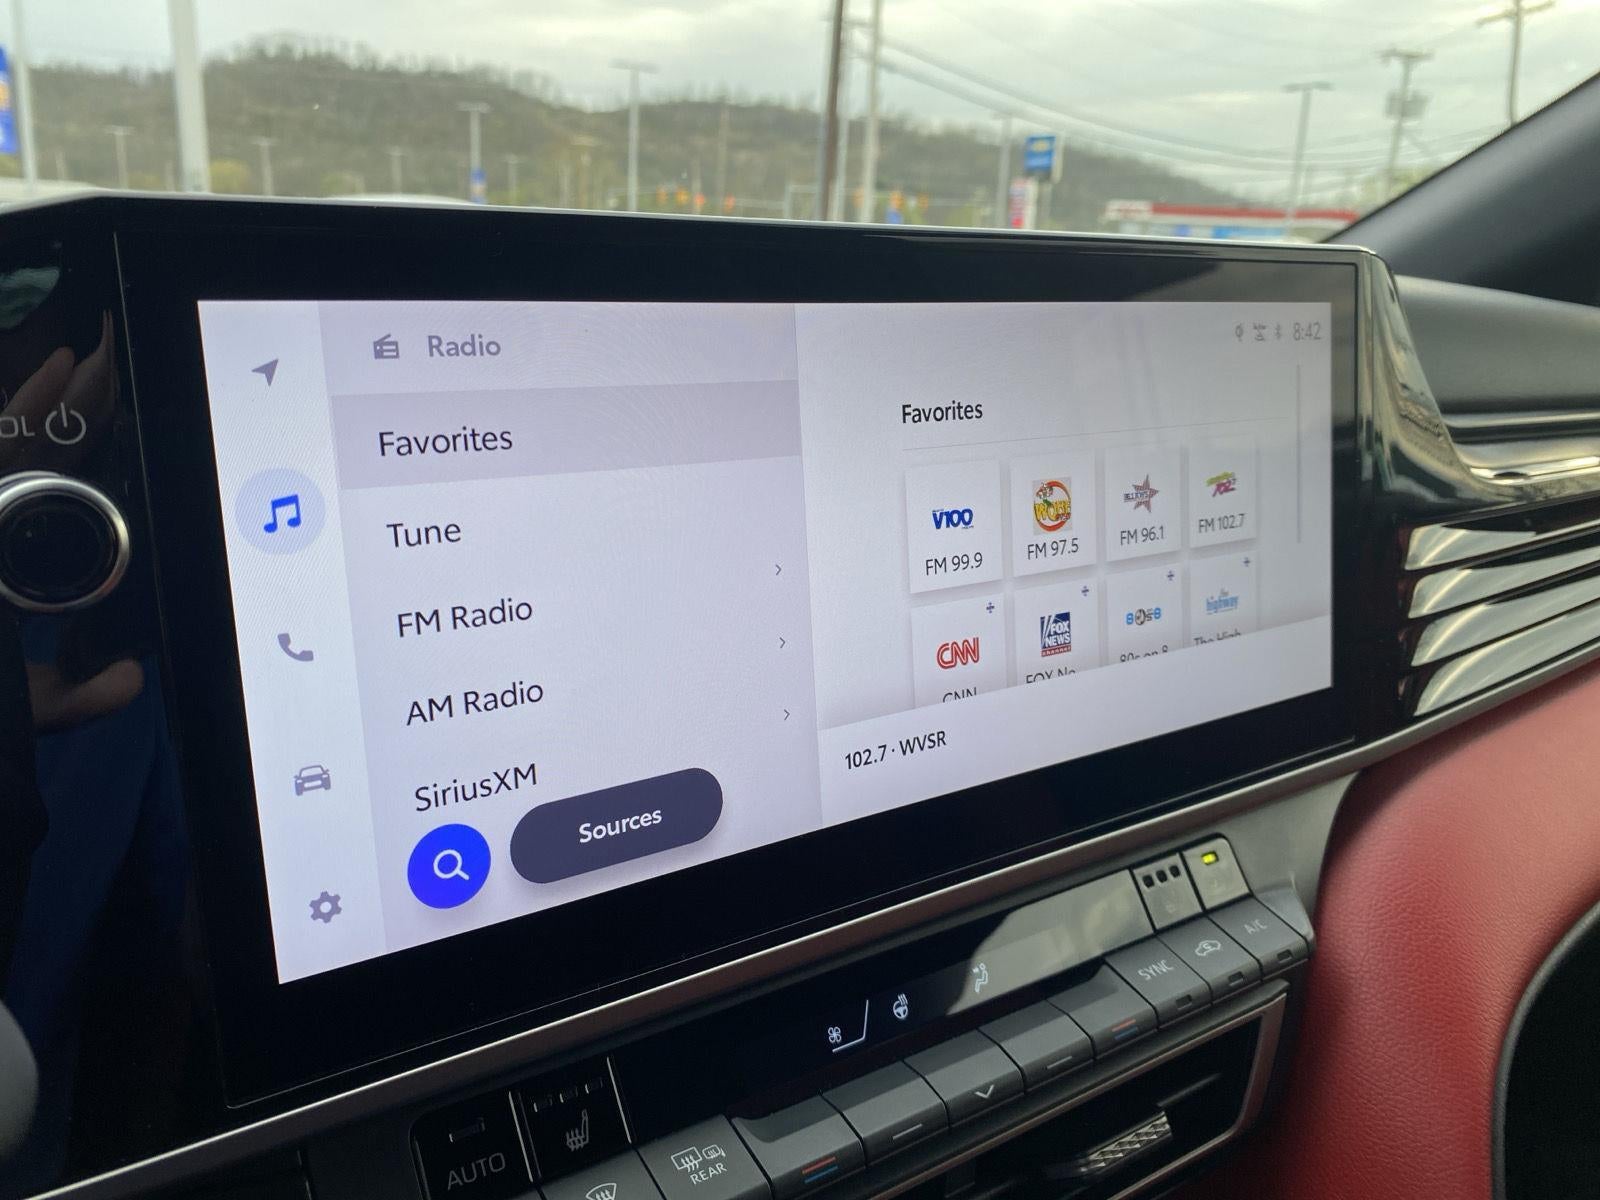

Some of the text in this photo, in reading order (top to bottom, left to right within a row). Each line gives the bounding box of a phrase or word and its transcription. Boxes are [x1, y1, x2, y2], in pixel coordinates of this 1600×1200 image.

[1293, 321, 1321, 341] 8:42
[428, 333, 502, 358] Radio
[902, 400, 984, 424] Favorites
[378, 425, 514, 457] Favorites
[932, 508, 974, 530] V100
[1199, 513, 1246, 534] FM 102.7
[386, 522, 462, 548] Tune
[1120, 525, 1165, 546] FM 96.1
[1027, 537, 1079, 561] FM 97.5
[925, 552, 983, 577] FM 99.9
[397, 597, 533, 638] FM Radio
[1050, 622, 1069, 636] FOX
[1045, 632, 1071, 648] NEWS
[936, 636, 980, 670] CNN
[406, 680, 544, 726] AM Radio
[845, 744, 887, 770] 102.7
[899, 730, 947, 756] WVSR
[414, 762, 538, 812] SiriusXM
[578, 809, 663, 843] Sources
[1244, 918, 1268, 935] A/C
[1138, 959, 1175, 981] SYNC
[447, 1152, 506, 1190] AUTO
[690, 1162, 728, 1186] REAR
